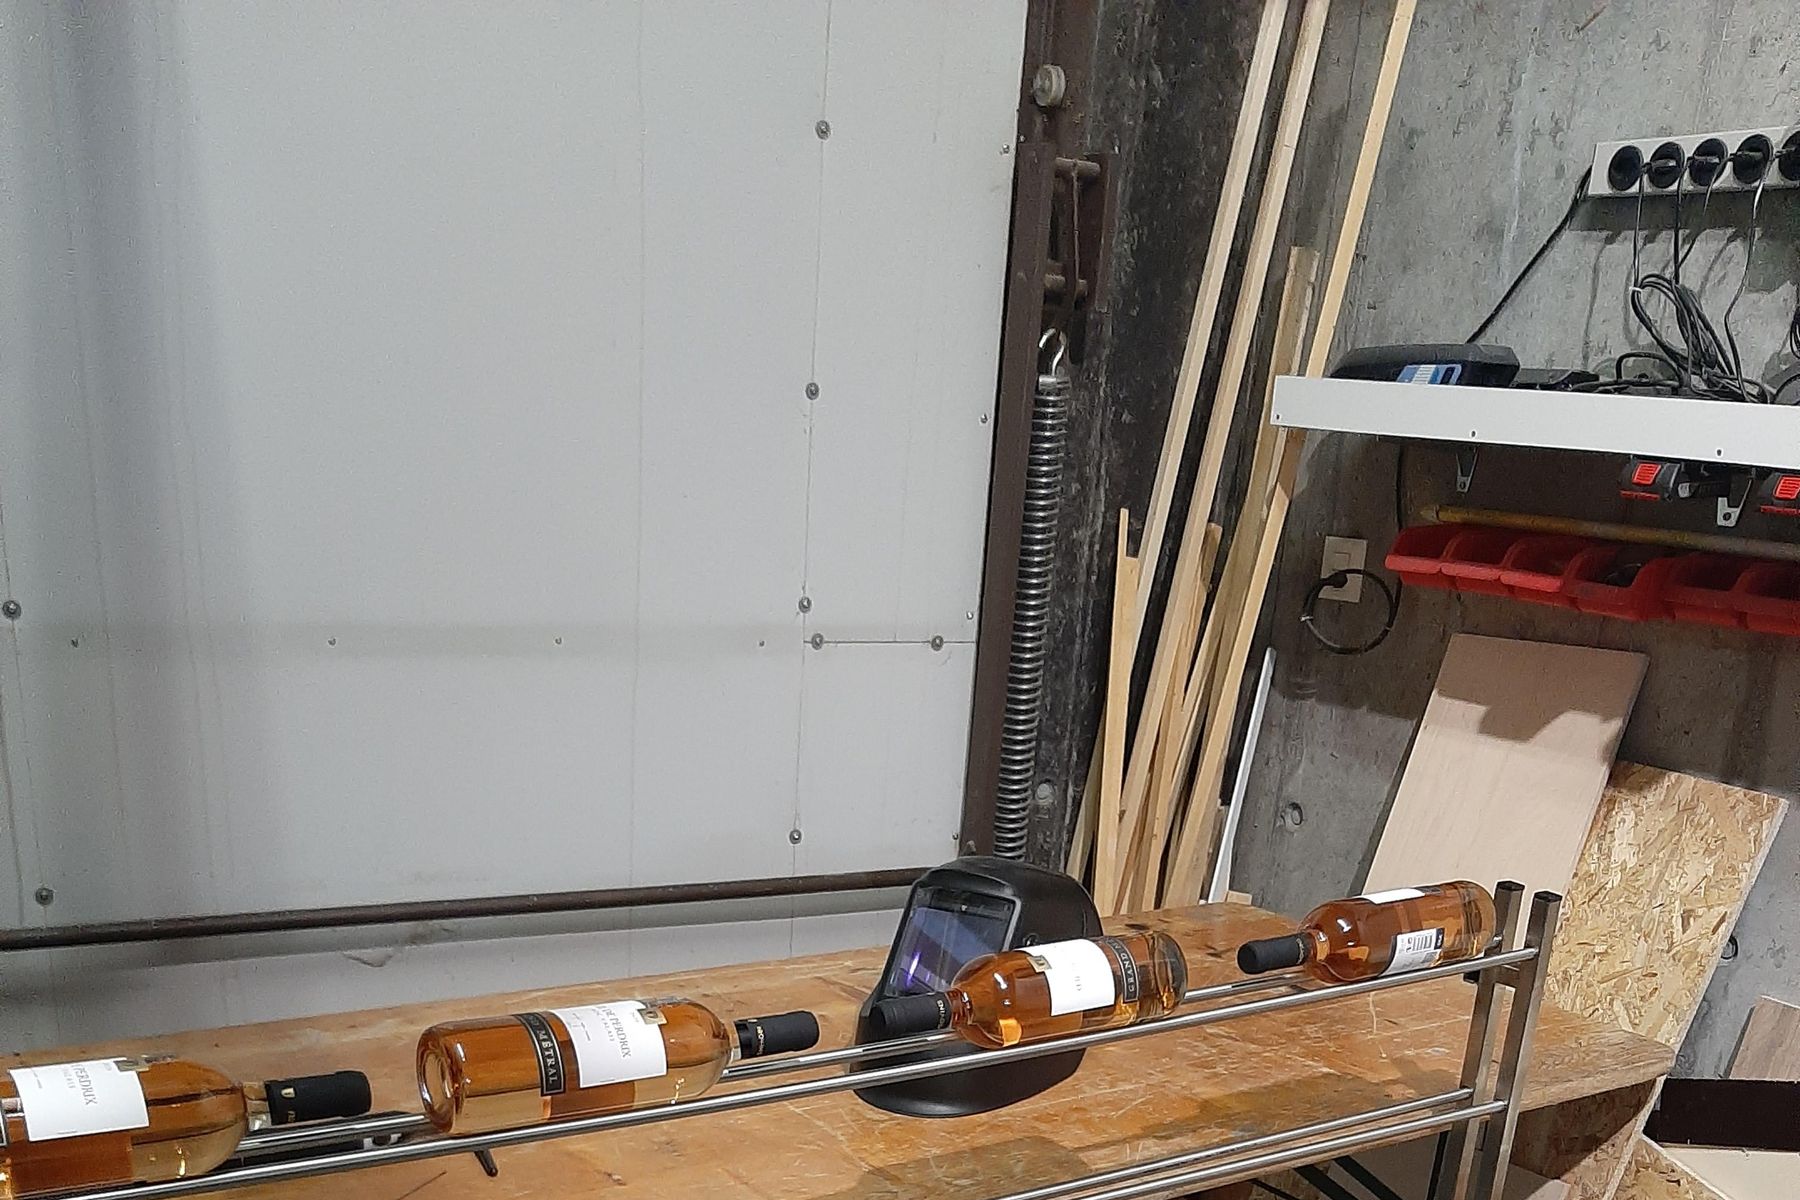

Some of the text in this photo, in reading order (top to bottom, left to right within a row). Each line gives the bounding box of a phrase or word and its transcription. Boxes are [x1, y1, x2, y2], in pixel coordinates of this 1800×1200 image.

[1120, 953, 1136, 992] GRAND
[537, 1029, 558, 1084] MÉTRAL
[609, 1017, 632, 1059] PERDRIX
